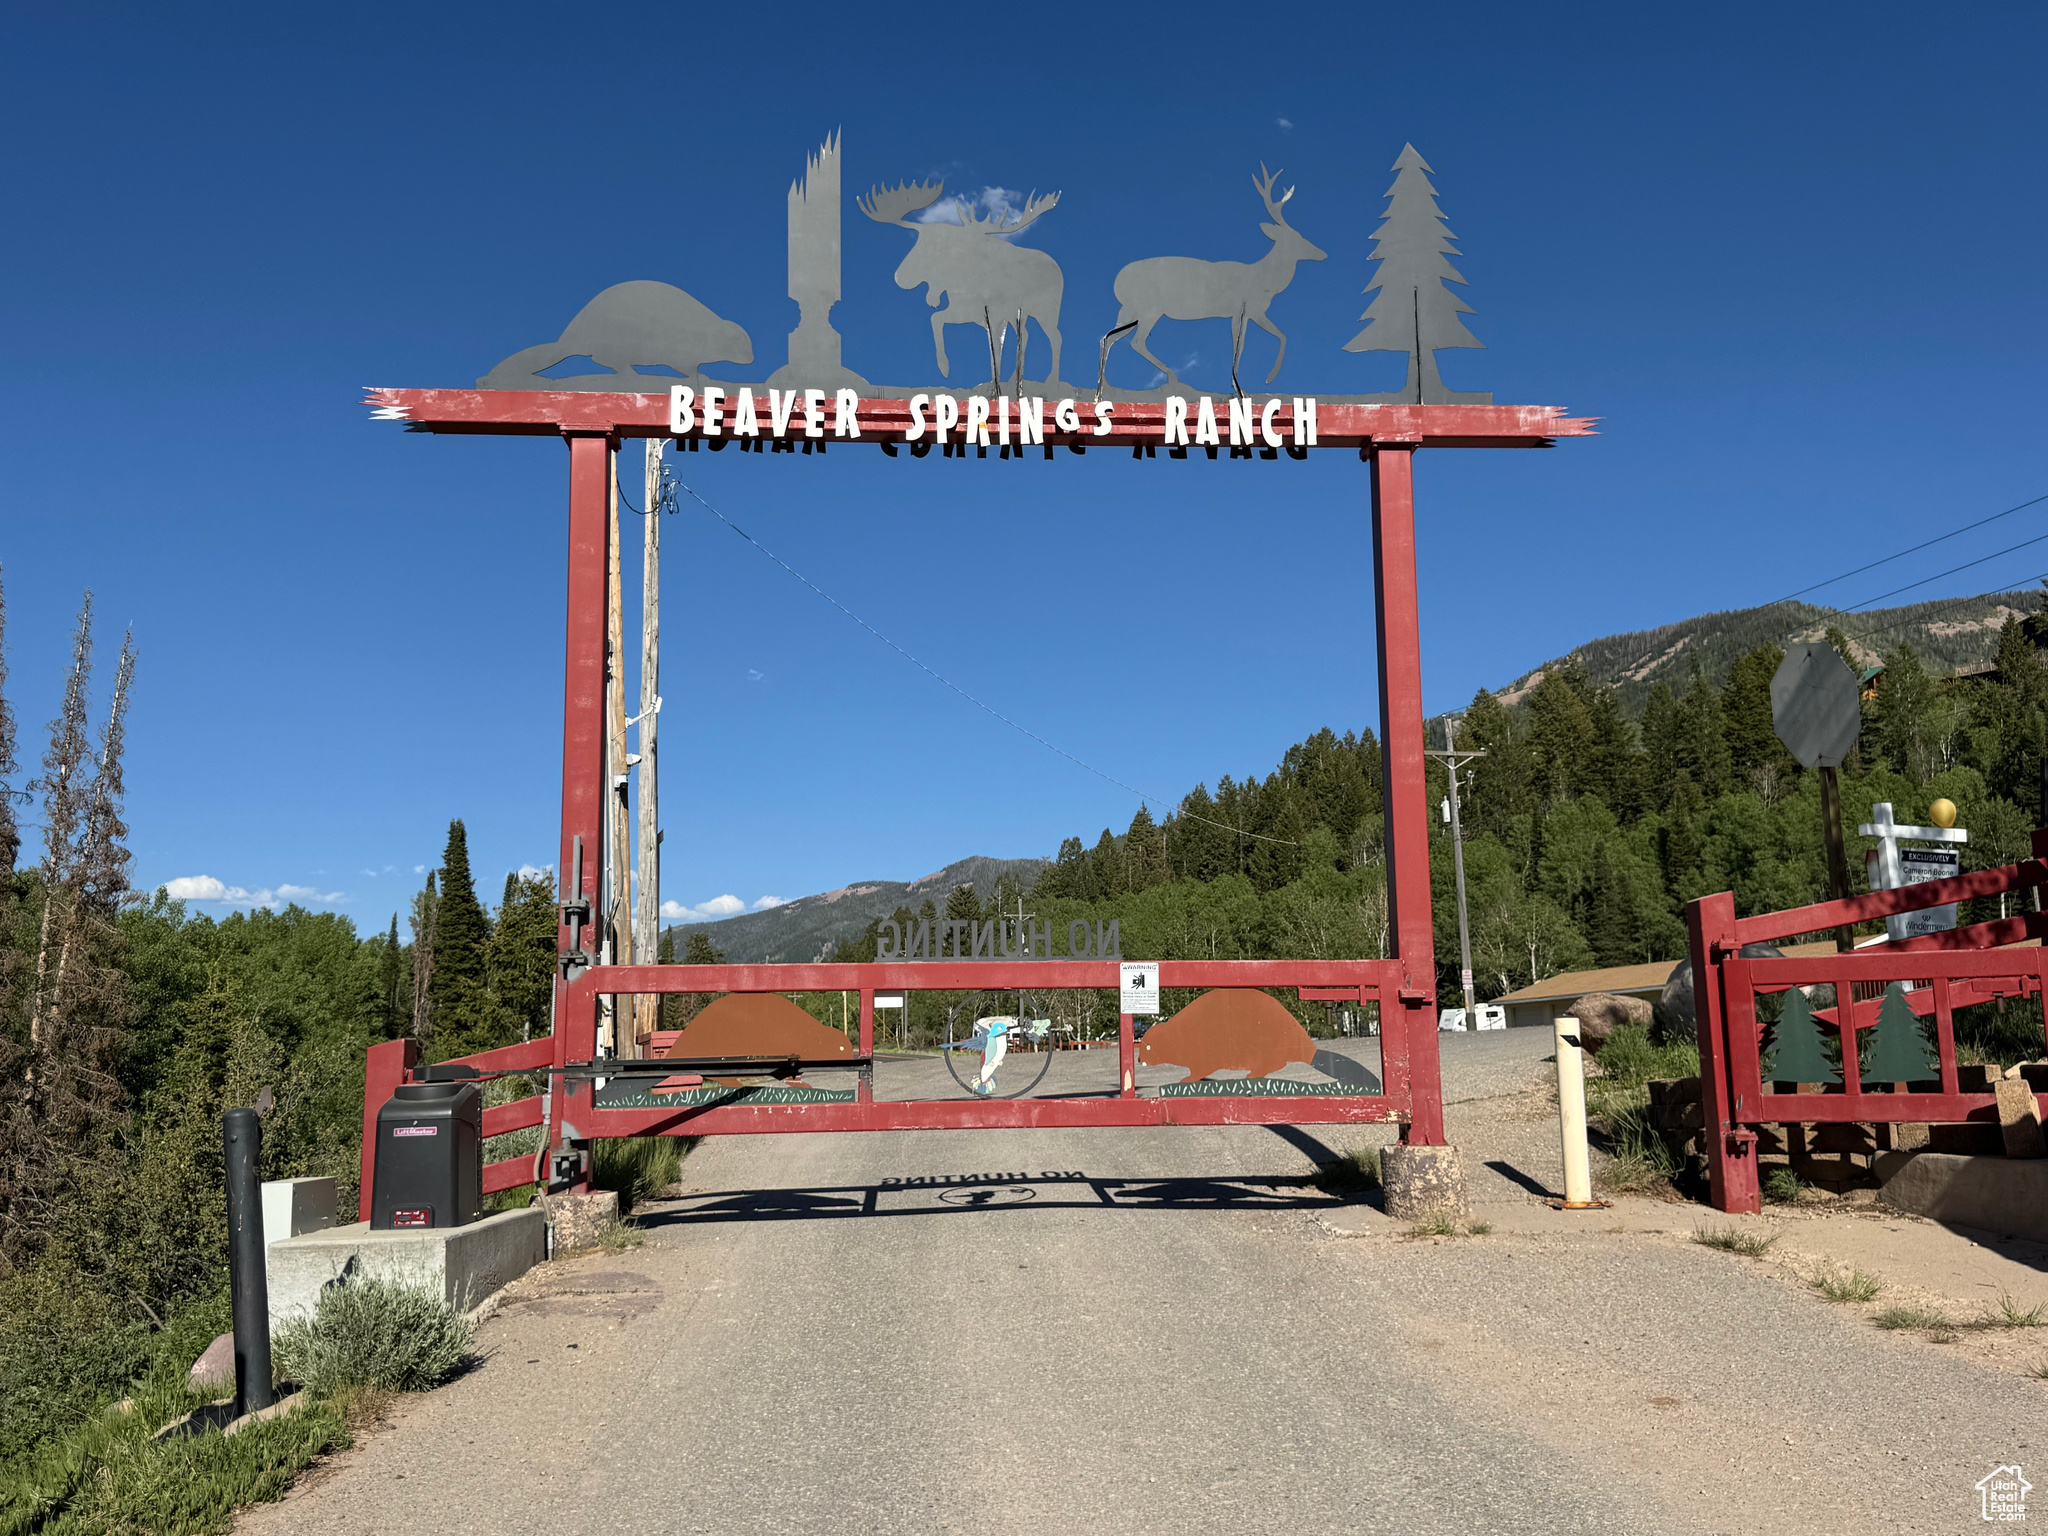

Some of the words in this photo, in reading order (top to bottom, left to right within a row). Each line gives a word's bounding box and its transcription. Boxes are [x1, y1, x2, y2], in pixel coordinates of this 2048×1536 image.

[670, 384, 861, 439] BEAVER
[905, 393, 1114, 447] SPRINGS
[1164, 395, 1317, 448] RANCH
[1908, 853, 1950, 863] EXCLUSIVELY
[1903, 866, 1932, 876] Cameron
[1933, 868, 1954, 876] Boone
